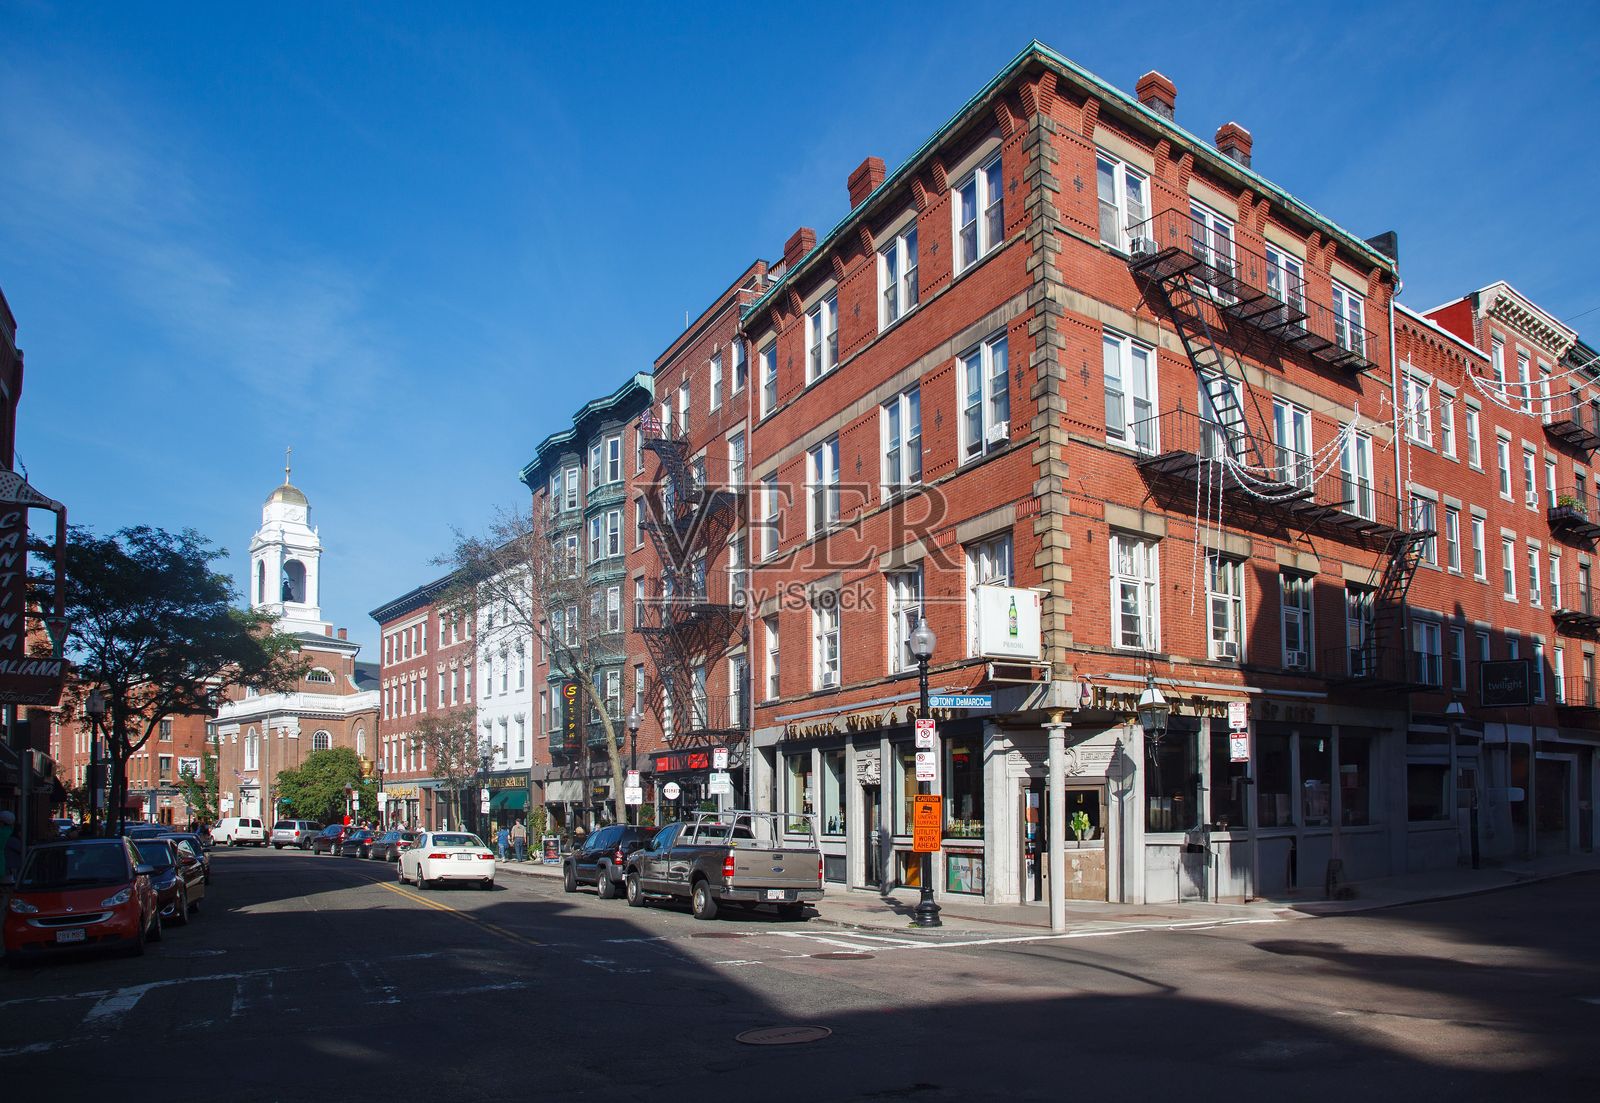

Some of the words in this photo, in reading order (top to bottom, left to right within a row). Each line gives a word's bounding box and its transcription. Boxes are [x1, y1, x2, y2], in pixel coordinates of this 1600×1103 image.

[0, 511, 21, 651] CANTINA
[1488, 678, 1522, 692] twilight
[938, 697, 955, 706] TONY
[956, 697, 985, 706] DeMARCO
